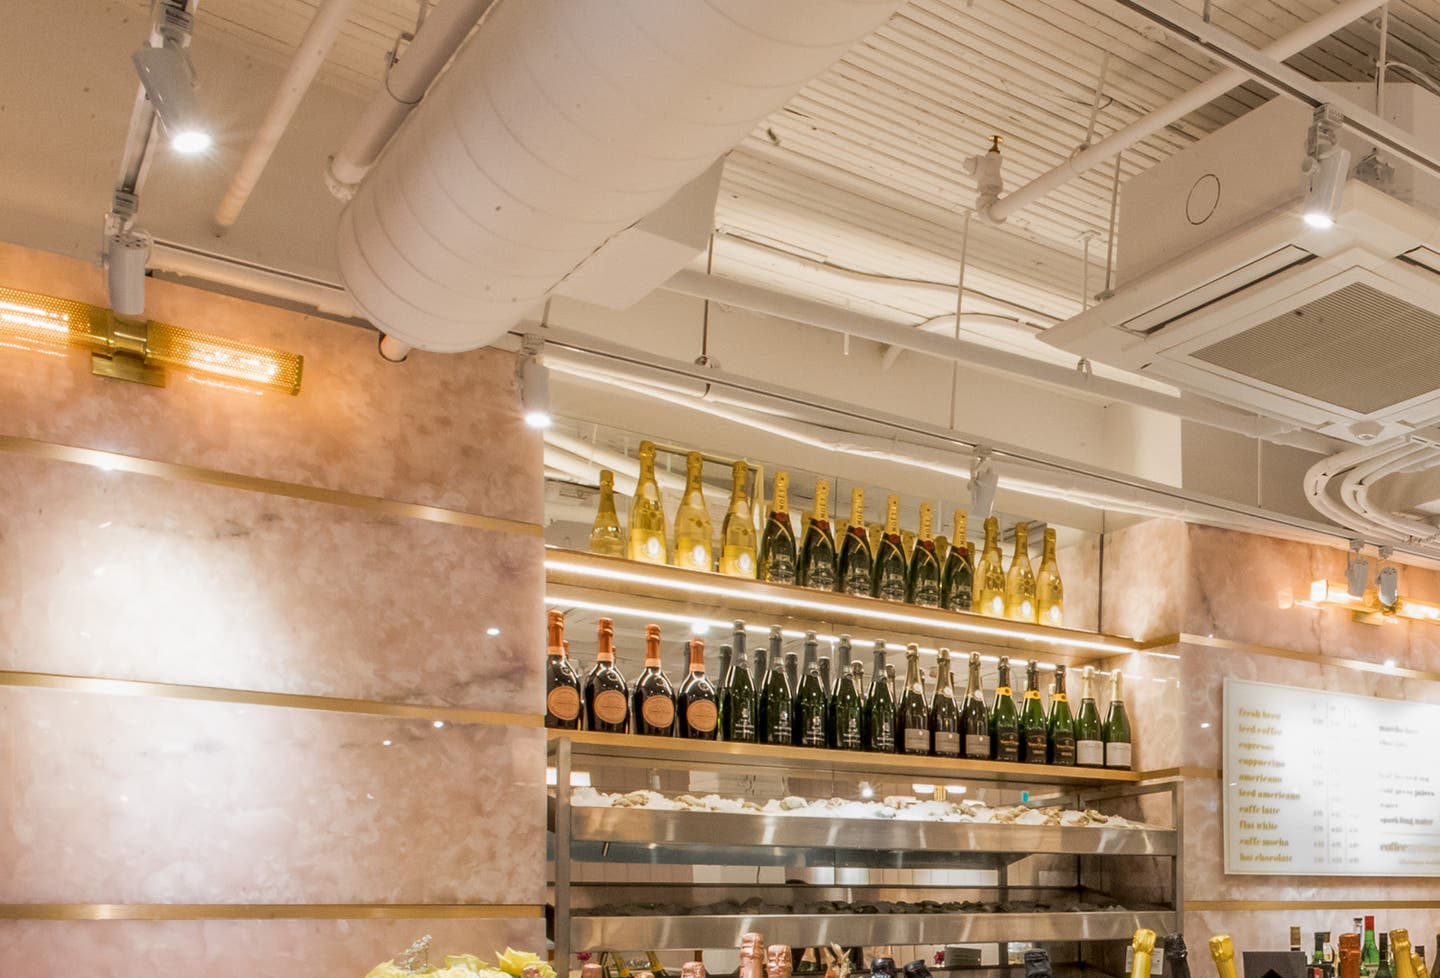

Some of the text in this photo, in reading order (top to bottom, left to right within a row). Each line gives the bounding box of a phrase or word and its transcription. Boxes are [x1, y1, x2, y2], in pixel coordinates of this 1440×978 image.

[1238, 773, 1283, 784] americano
[1257, 790, 1301, 801] americano
[1261, 805, 1281, 815] latte
[1256, 821, 1278, 831] white
[1261, 837, 1290, 848] mocha
[1254, 853, 1293, 864] chocolate
